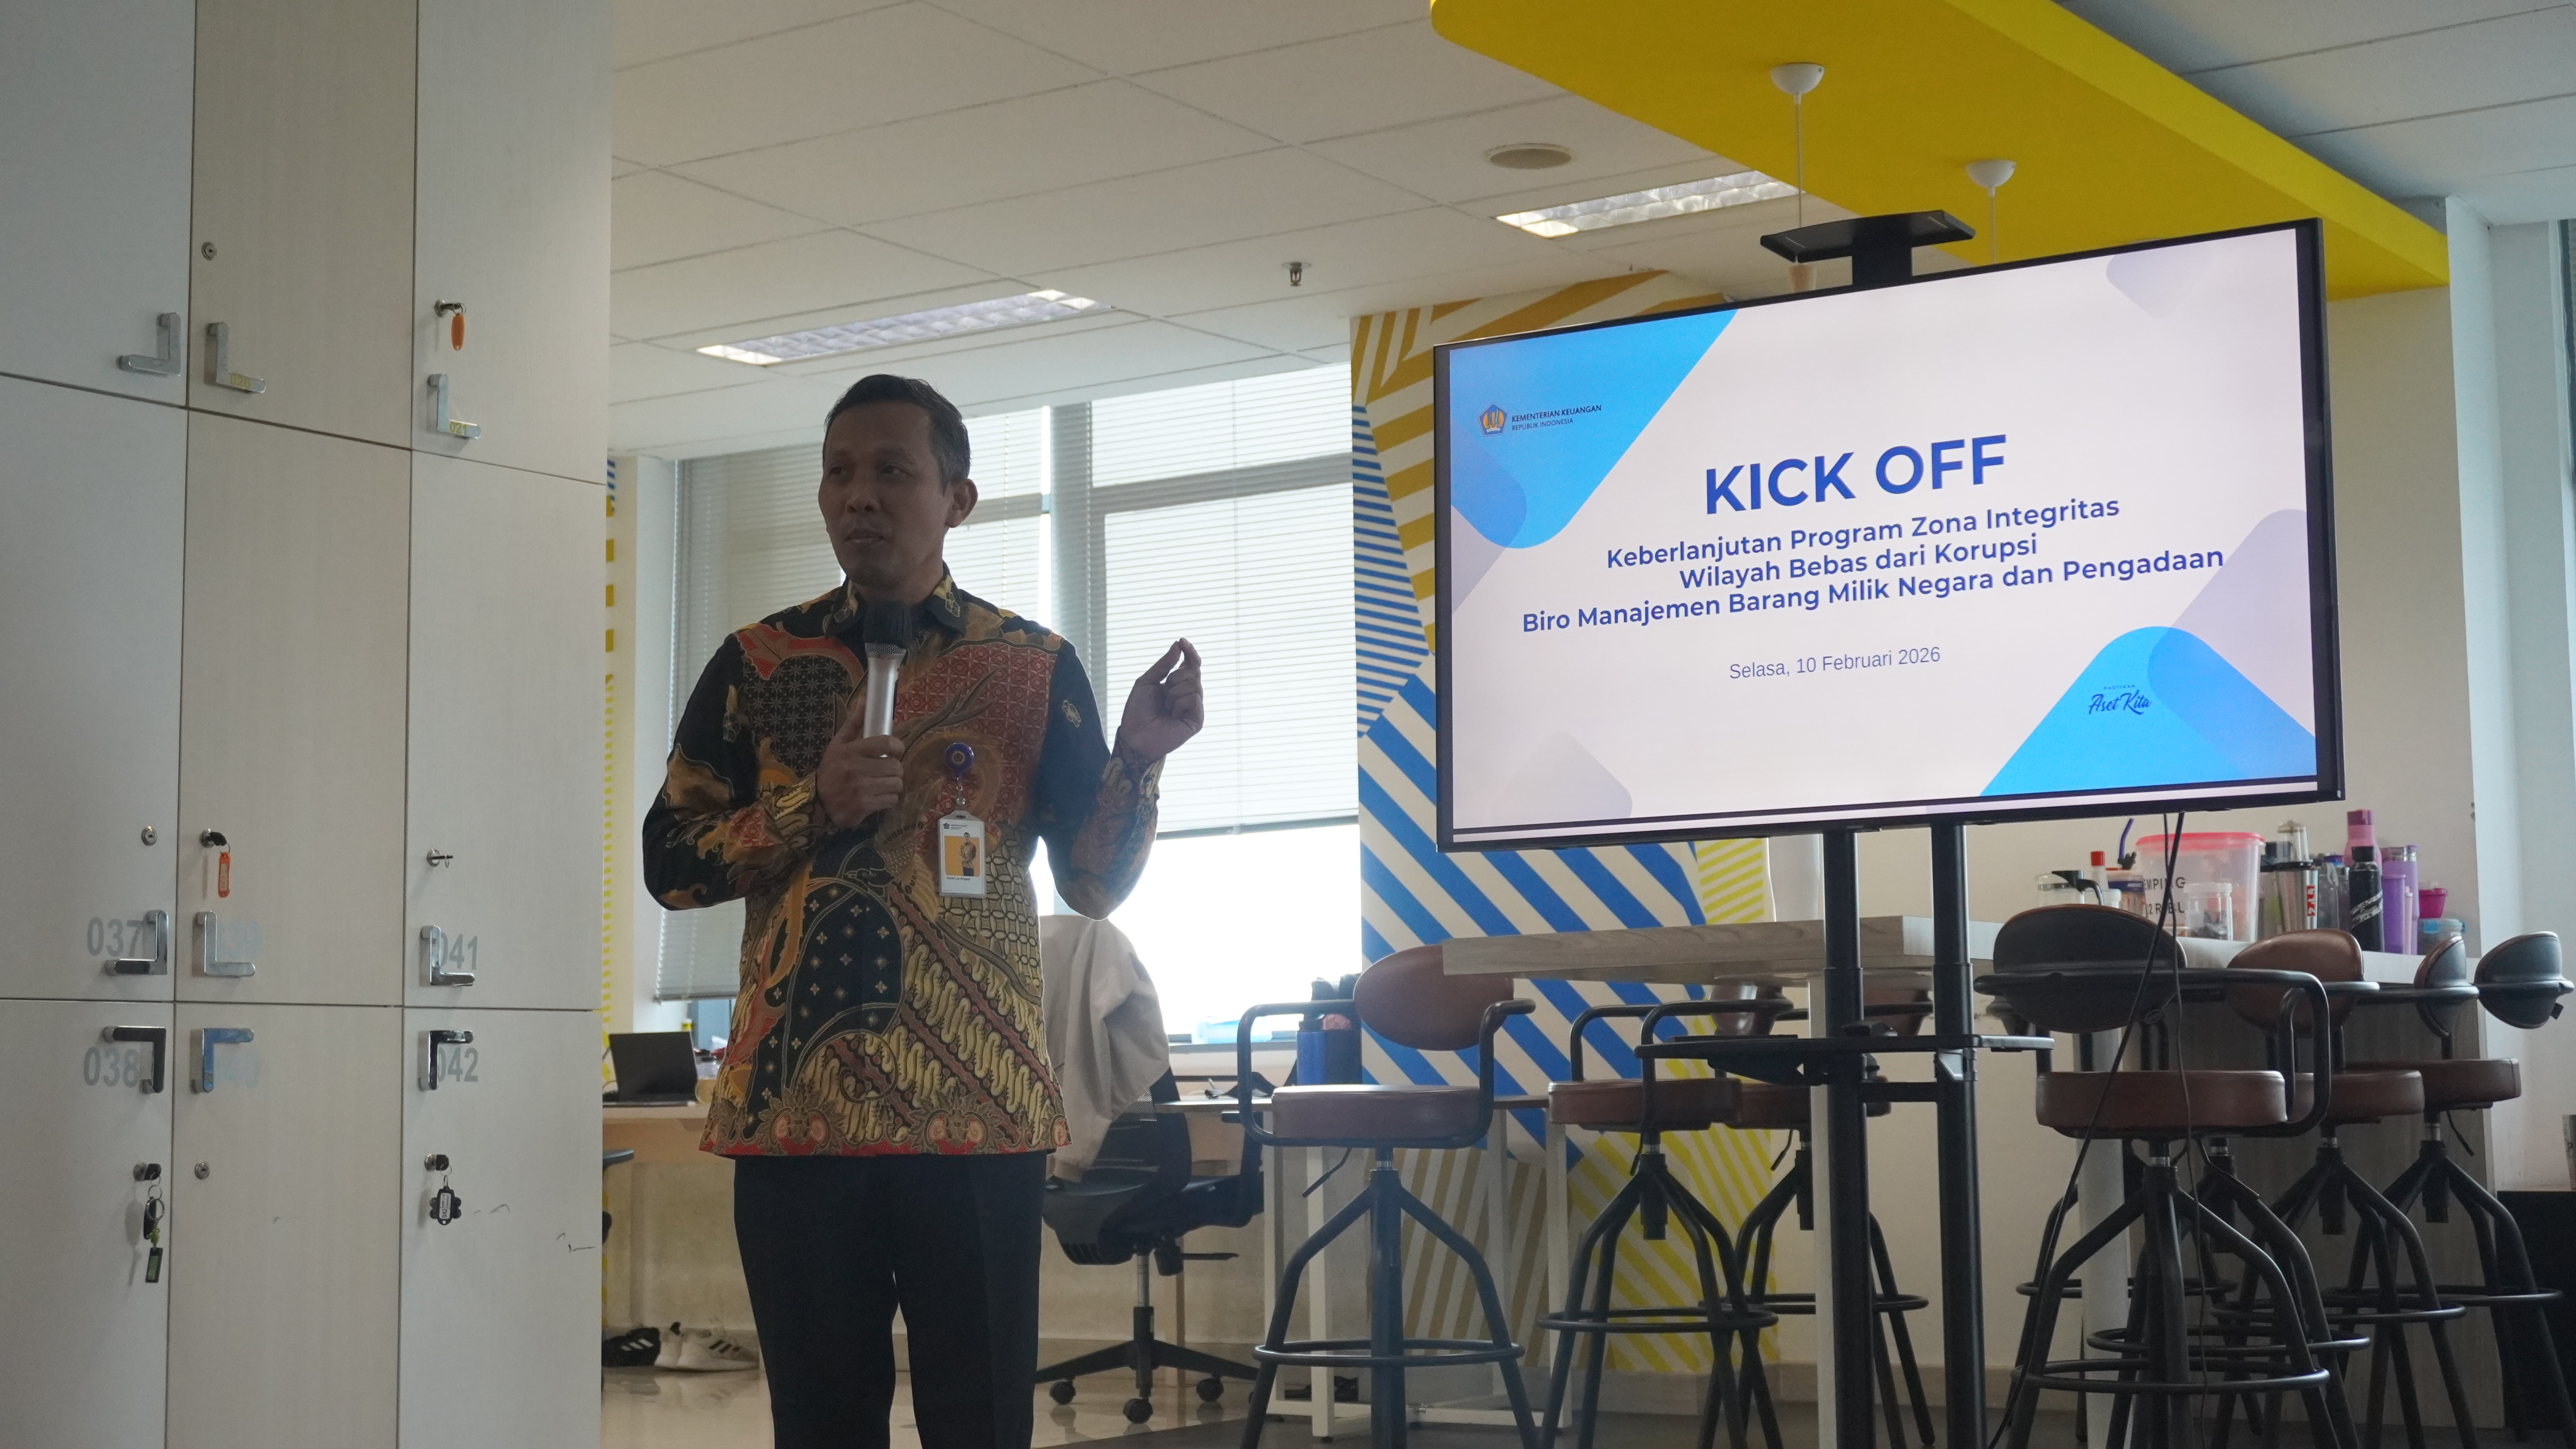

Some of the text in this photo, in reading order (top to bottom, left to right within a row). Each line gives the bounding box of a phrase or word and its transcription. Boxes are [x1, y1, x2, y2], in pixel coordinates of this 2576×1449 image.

[1512, 405, 1601, 422] KEMENTERIAN KEUANGAN
[1512, 418, 1574, 431] REPUBLIK INDONESIA
[1706, 434, 2006, 515] KICK OFF
[1608, 498, 2119, 568] Keberlanjutan Program Zona Integritas
[1680, 533, 2036, 588] Wilayah Bebas dari Korupsi
[1524, 550, 2223, 632] Biro Manajemen Barang Milik Negara dan Pengadaan
[1730, 647, 1940, 679] Selasa, 10 Februari 2026
[2089, 689, 2152, 715] Aset Kita
[87, 917, 144, 957] 037
[84, 1047, 140, 1088] 038
